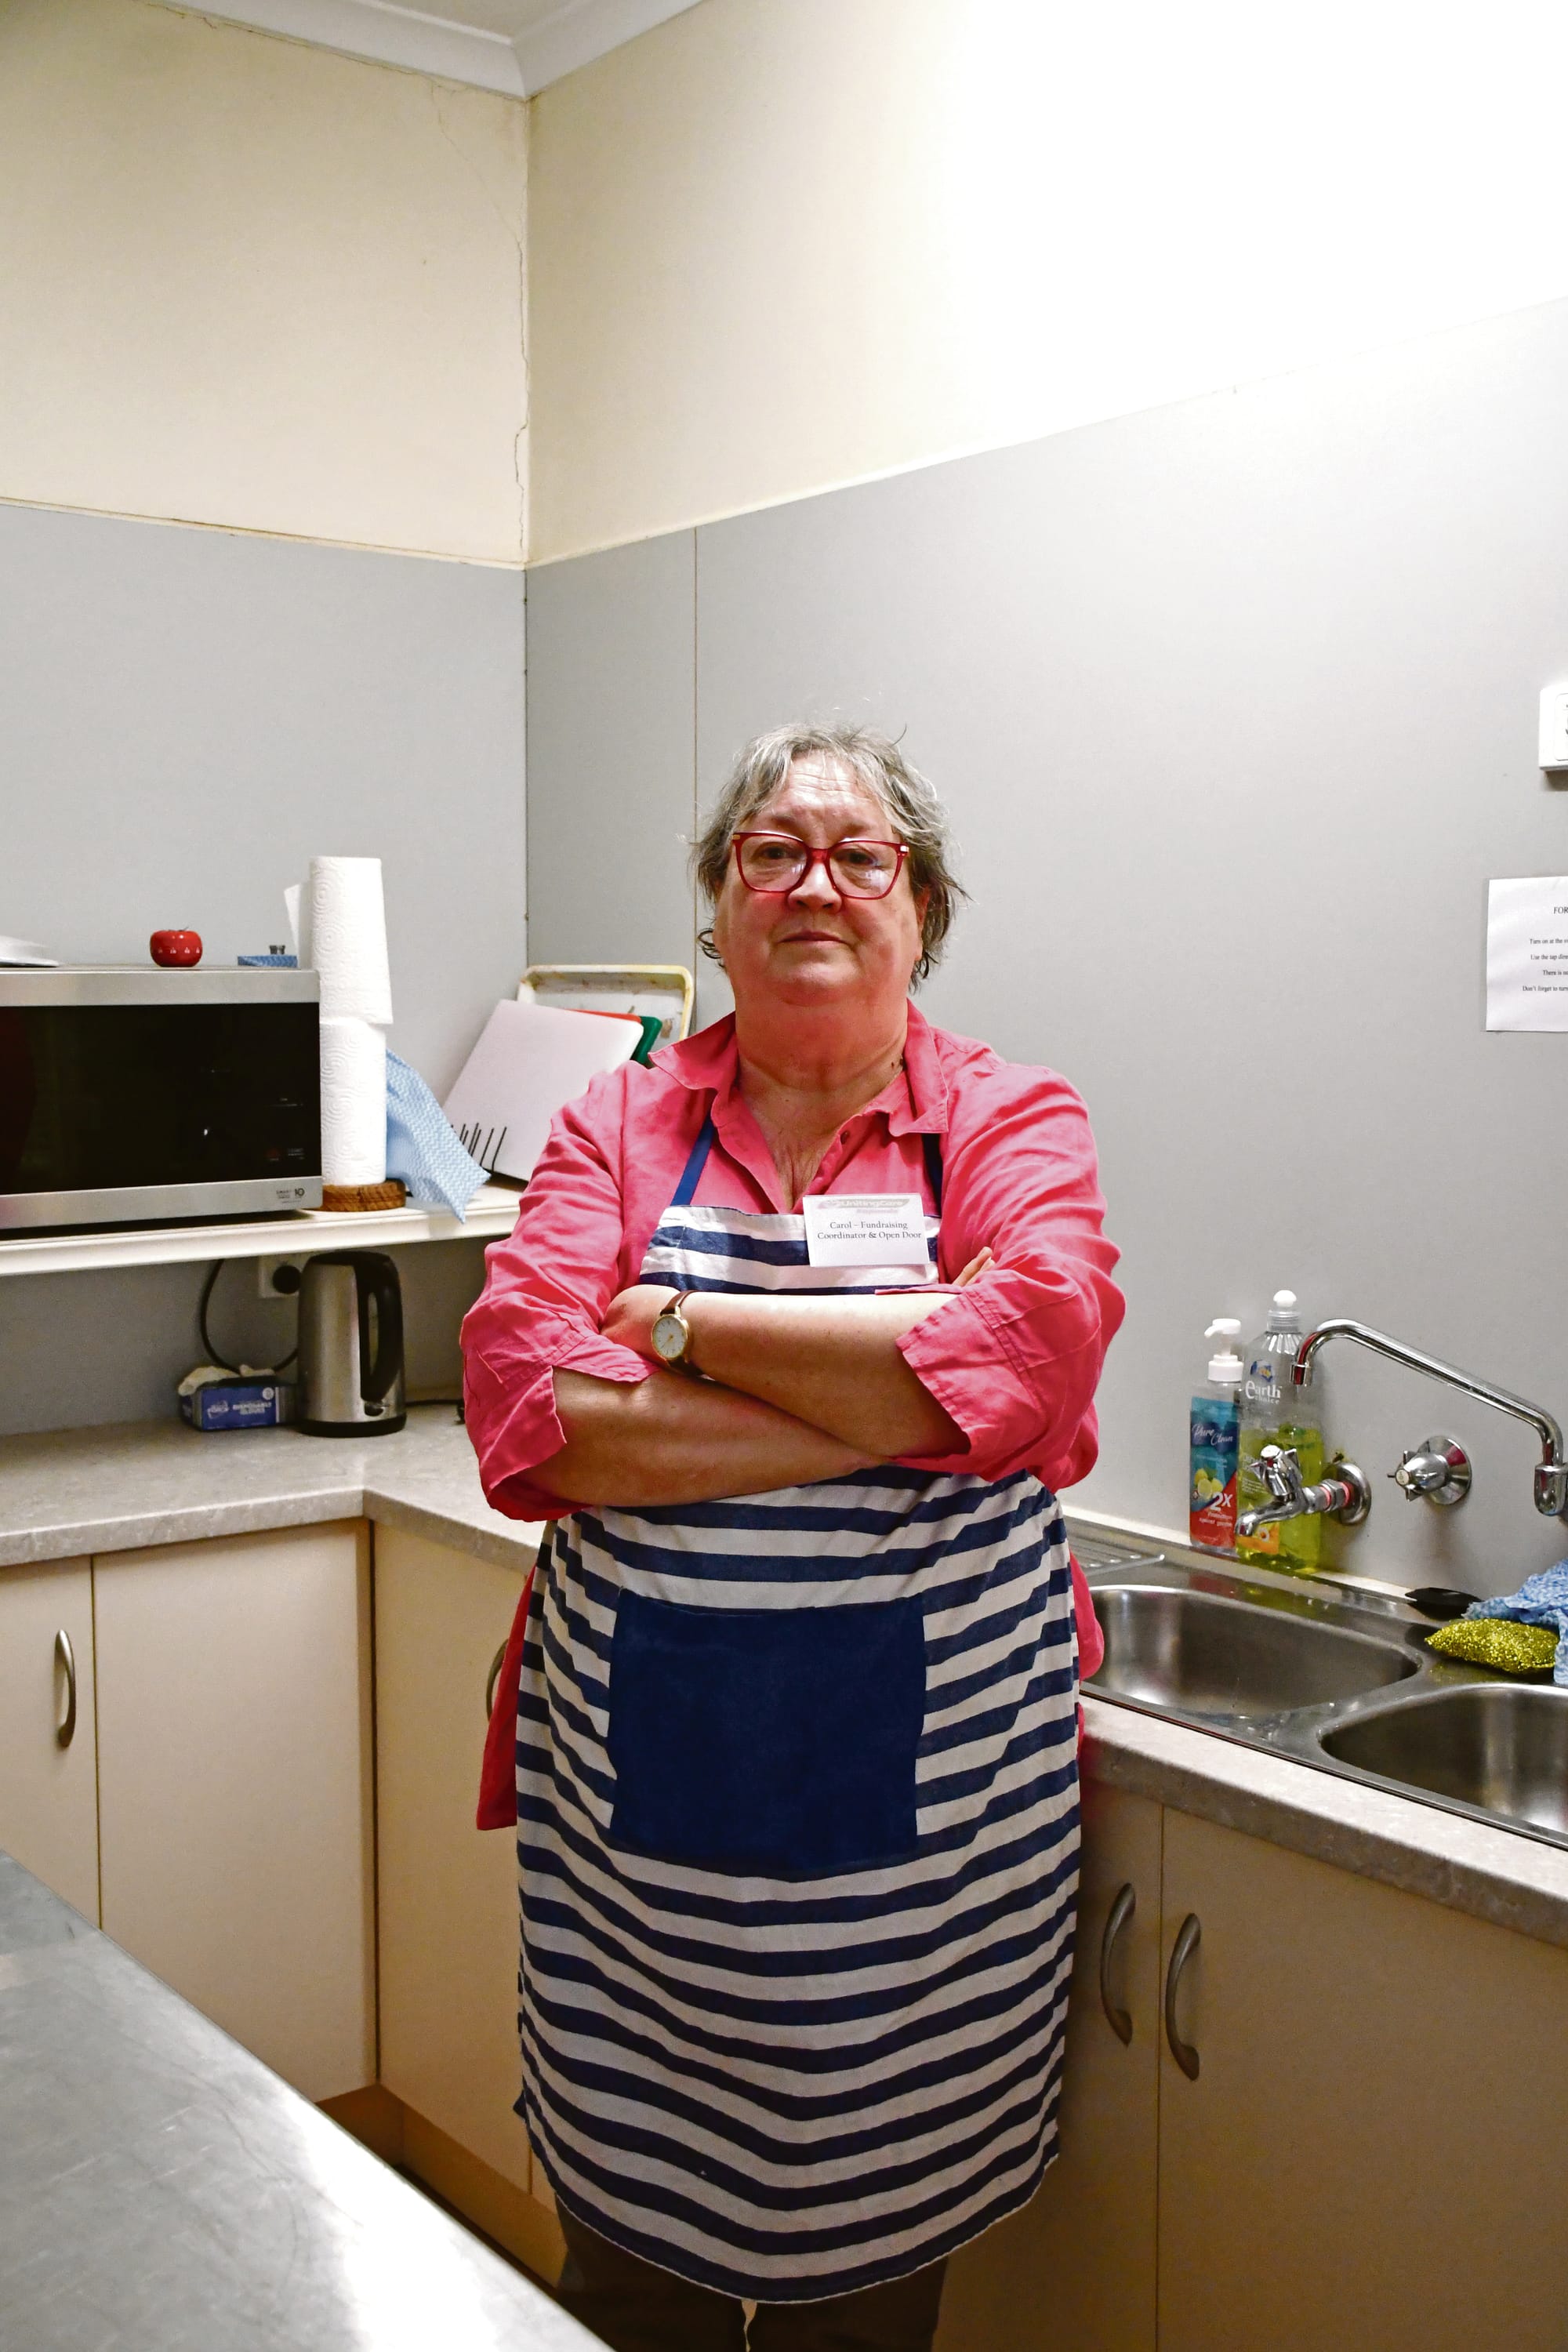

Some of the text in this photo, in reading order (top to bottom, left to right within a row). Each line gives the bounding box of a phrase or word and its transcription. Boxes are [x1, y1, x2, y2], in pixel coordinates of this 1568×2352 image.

[861, 1221, 908, 1230] Fundraising
[878, 1231, 900, 1240] Open
[1245, 1381, 1281, 1399] earth
[1192, 1423, 1215, 1439] Pure
[1210, 1432, 1233, 1446] Clean
